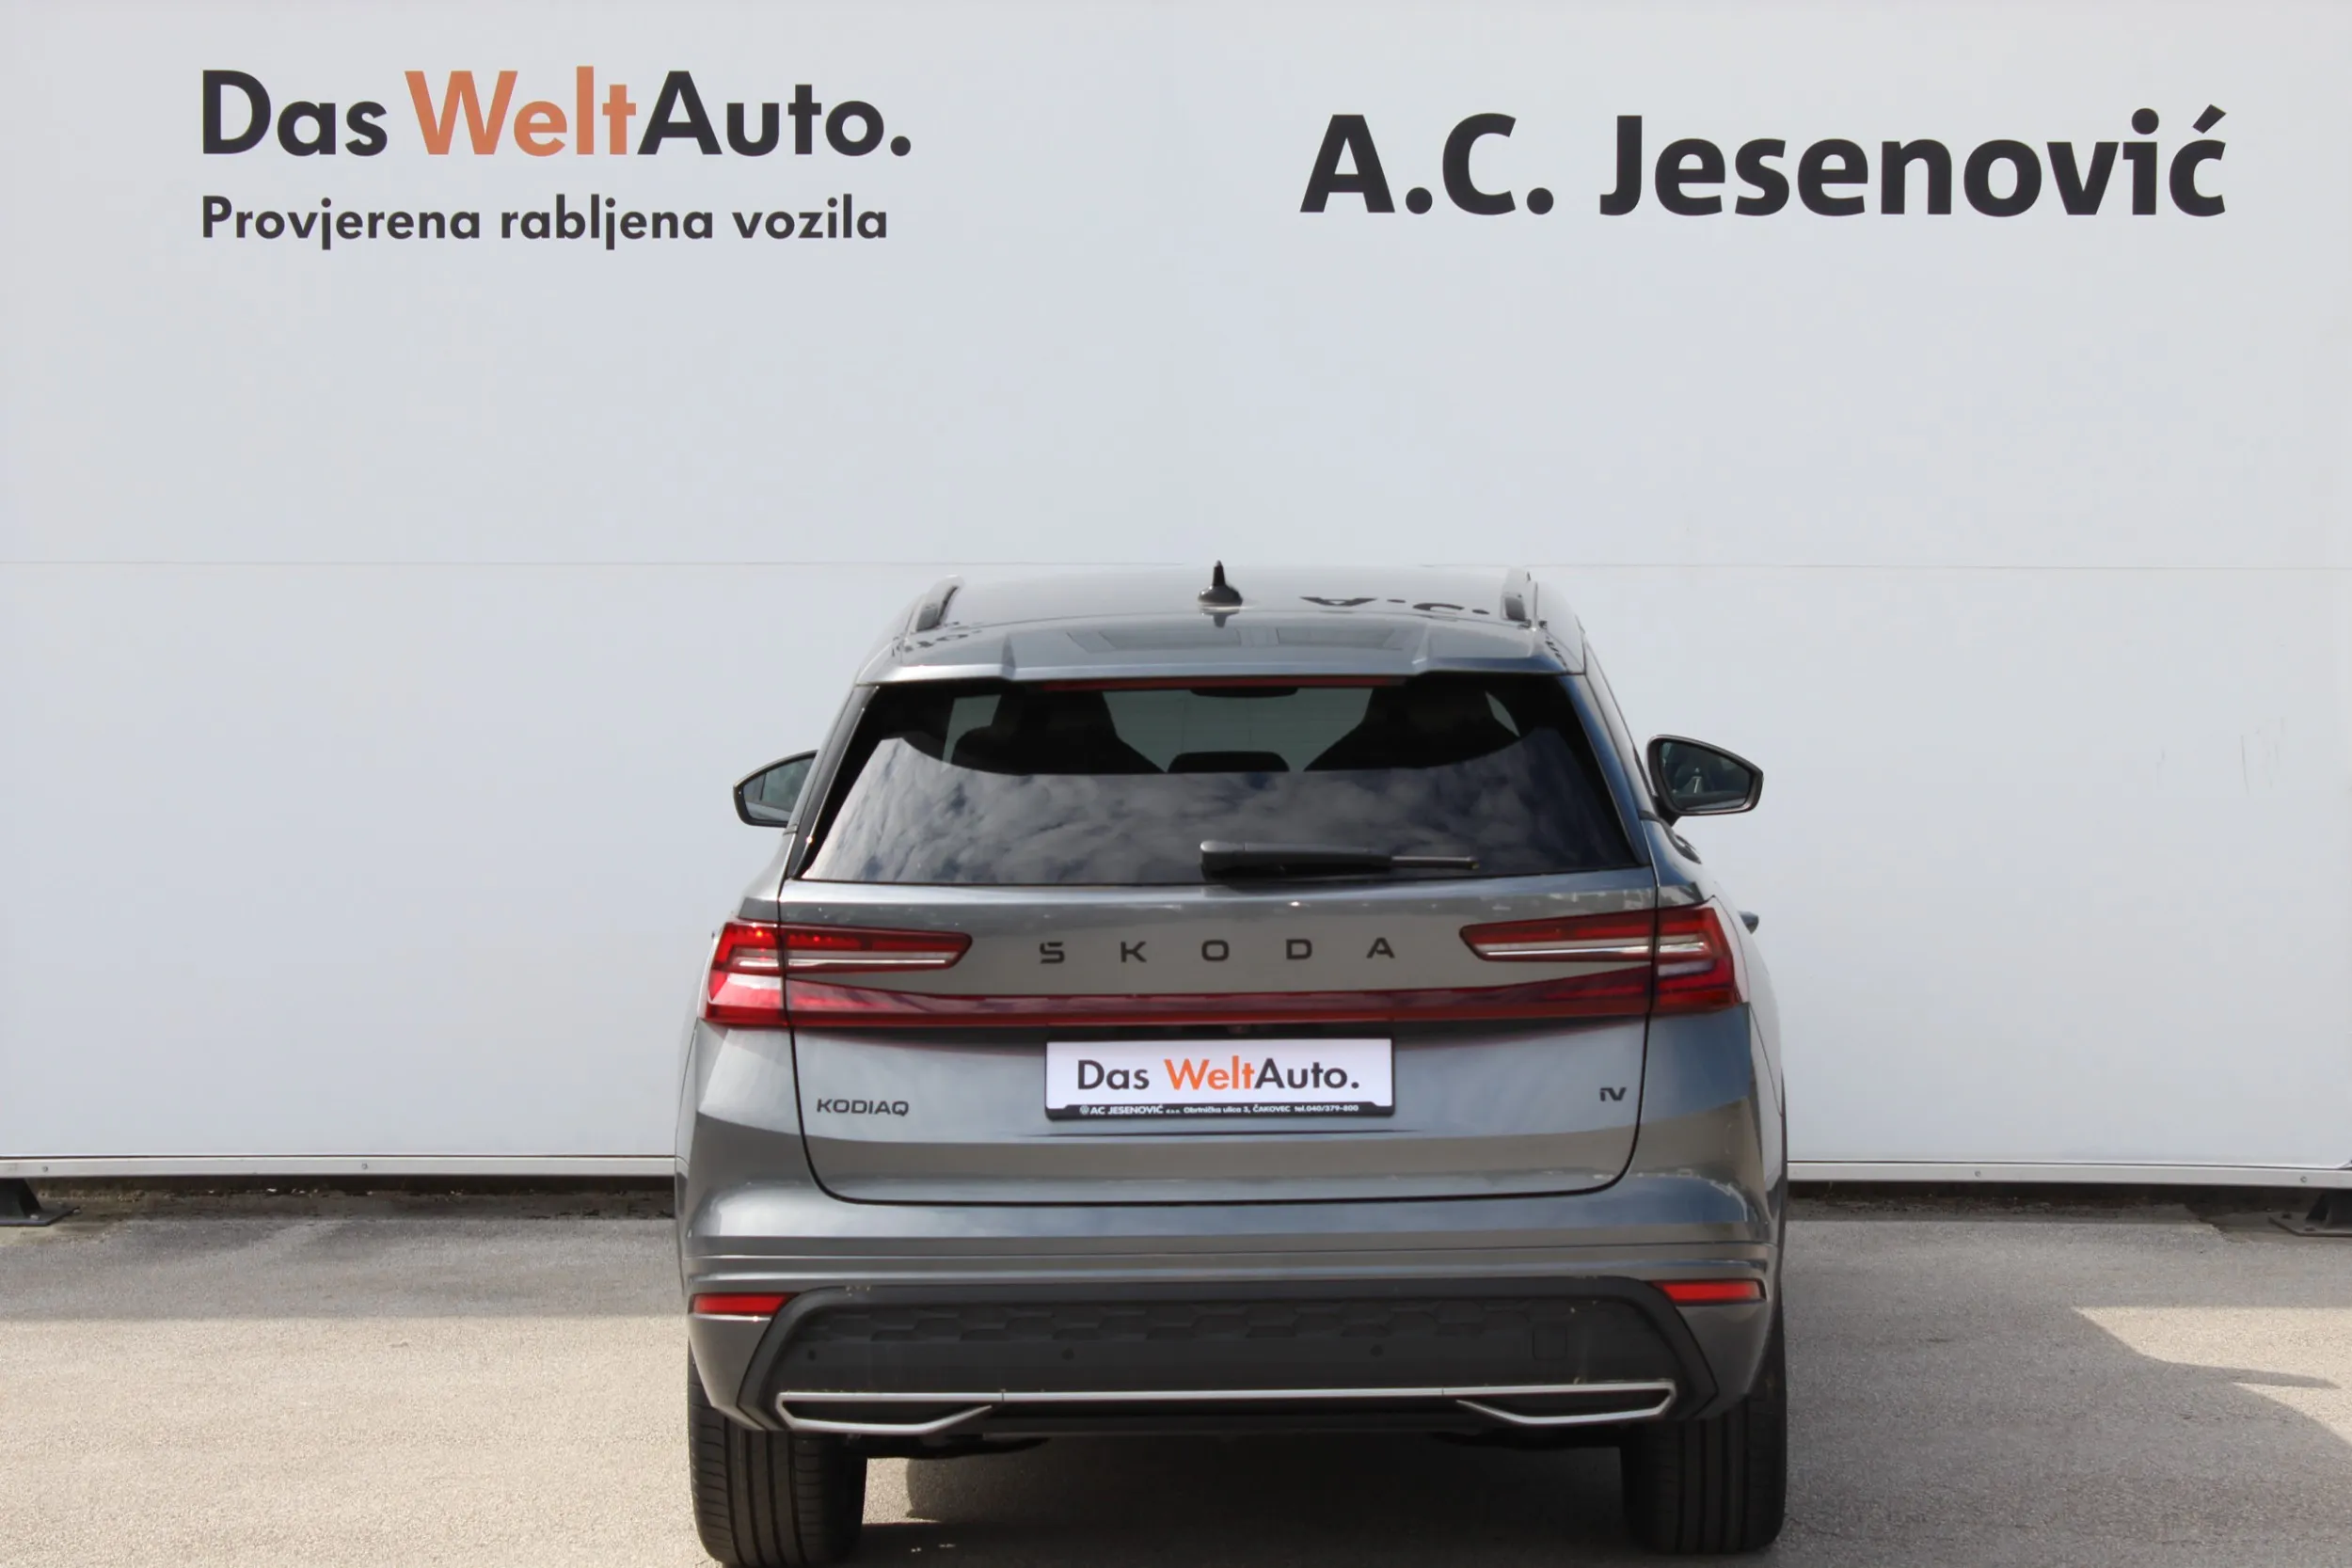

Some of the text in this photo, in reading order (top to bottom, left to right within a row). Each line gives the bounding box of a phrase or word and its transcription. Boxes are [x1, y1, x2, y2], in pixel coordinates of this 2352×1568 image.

[202, 65, 912, 157] Das WeltAuto.
[1299, 103, 2227, 218] A.C. Jesenović
[202, 193, 887, 251] Provjerena rabljena vozila
[1077, 1054, 1360, 1091] Das WeltAuto.
[816, 1098, 910, 1117] KODIAQ
[1089, 1106, 1105, 1116] AC
[1107, 1104, 1164, 1116] JESENOVIĆ
[1222, 1105, 1242, 1114] ulica
[1252, 1103, 1292, 1114] ČAKOVEC
